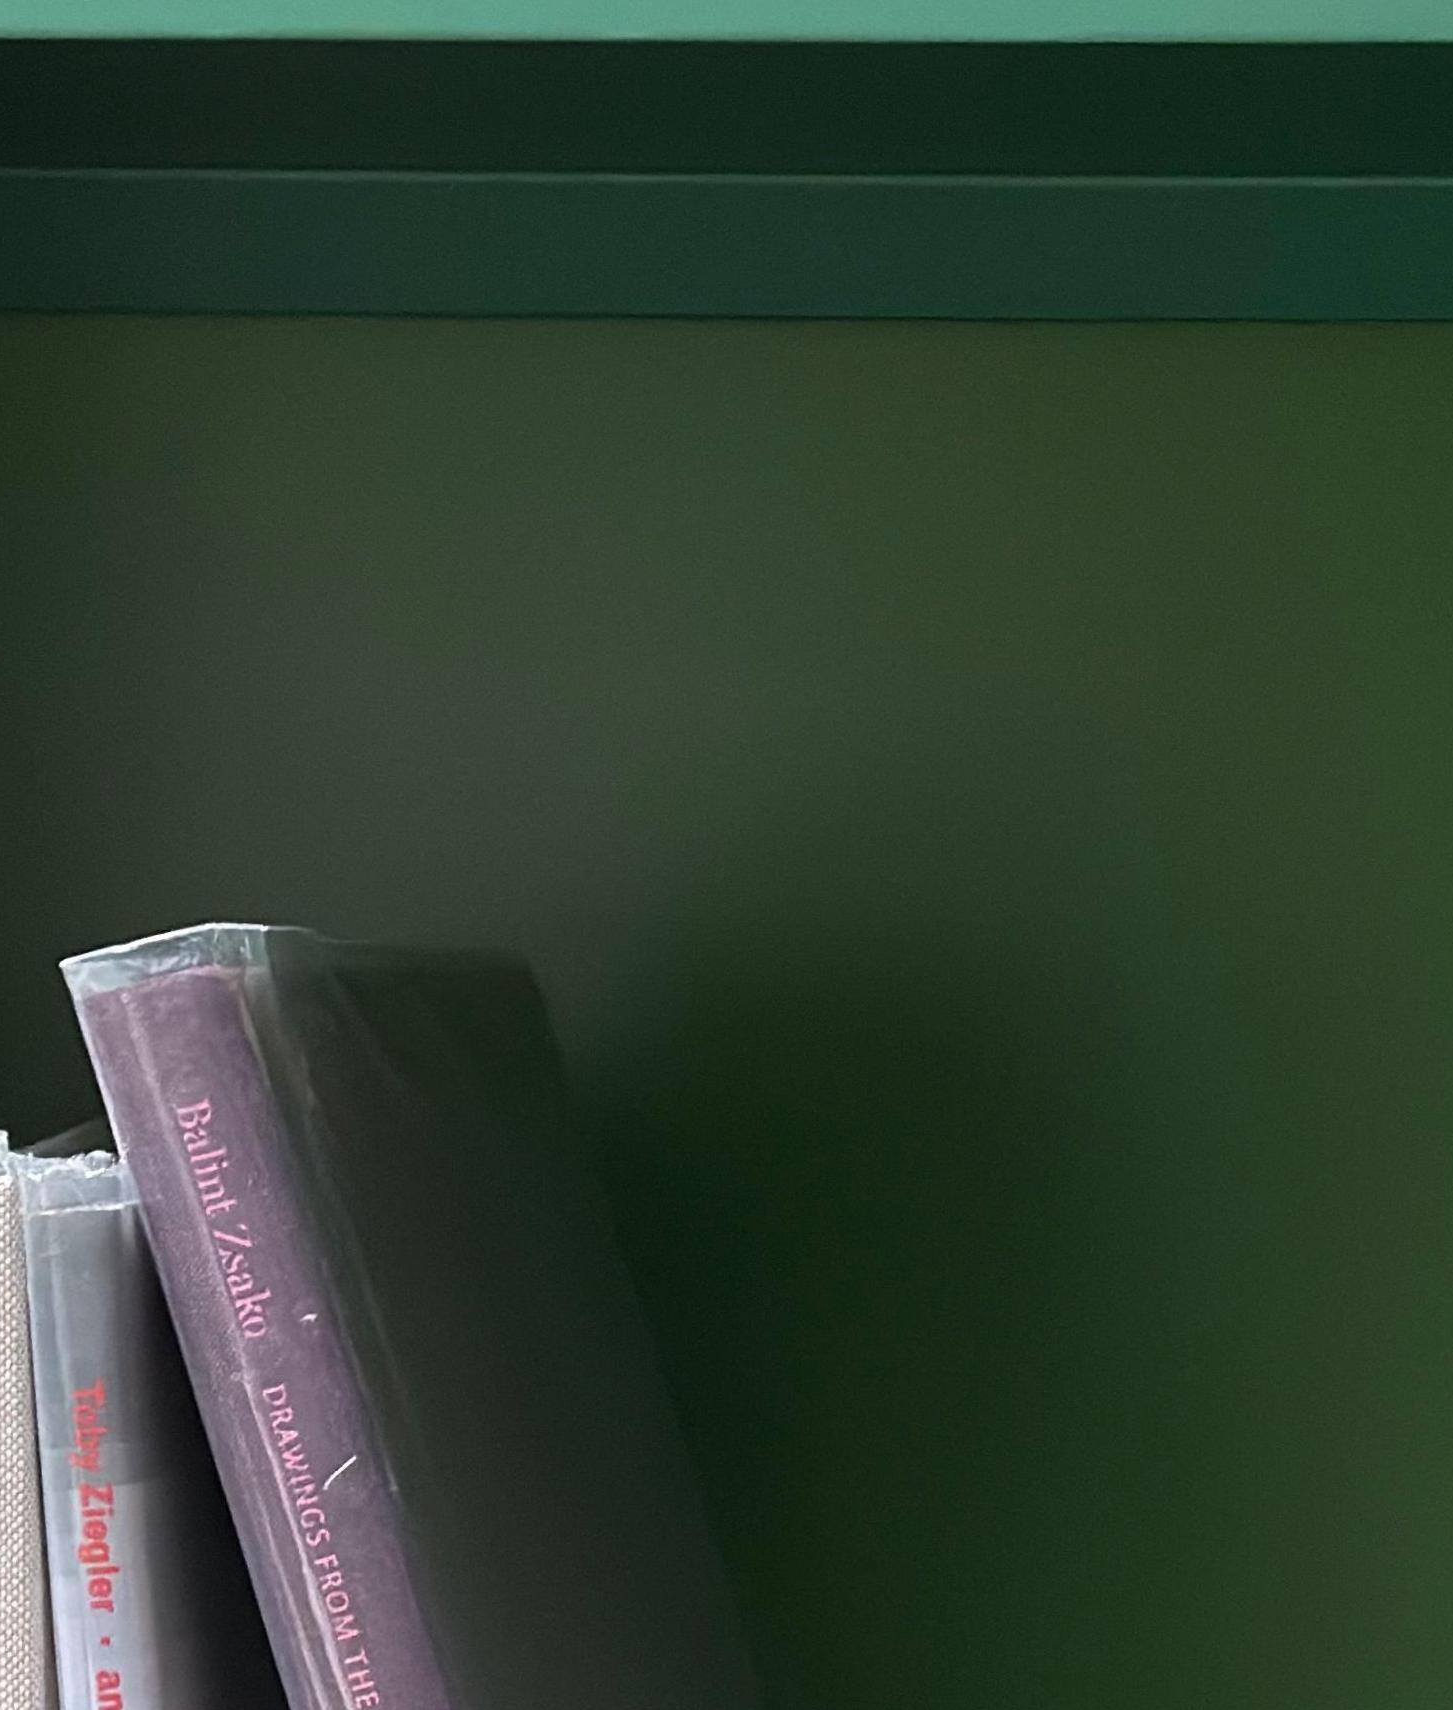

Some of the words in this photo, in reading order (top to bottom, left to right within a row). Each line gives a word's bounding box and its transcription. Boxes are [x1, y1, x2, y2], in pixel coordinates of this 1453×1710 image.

[213, 1223, 272, 1338] Zsako
[69, 1378, 108, 1473] Toby
[77, 1482, 121, 1614] Ziegler
[262, 1383, 330, 1547] DRAWINGS
[314, 1554, 360, 1641] FROM
[345, 1649, 380, 1709] THE
